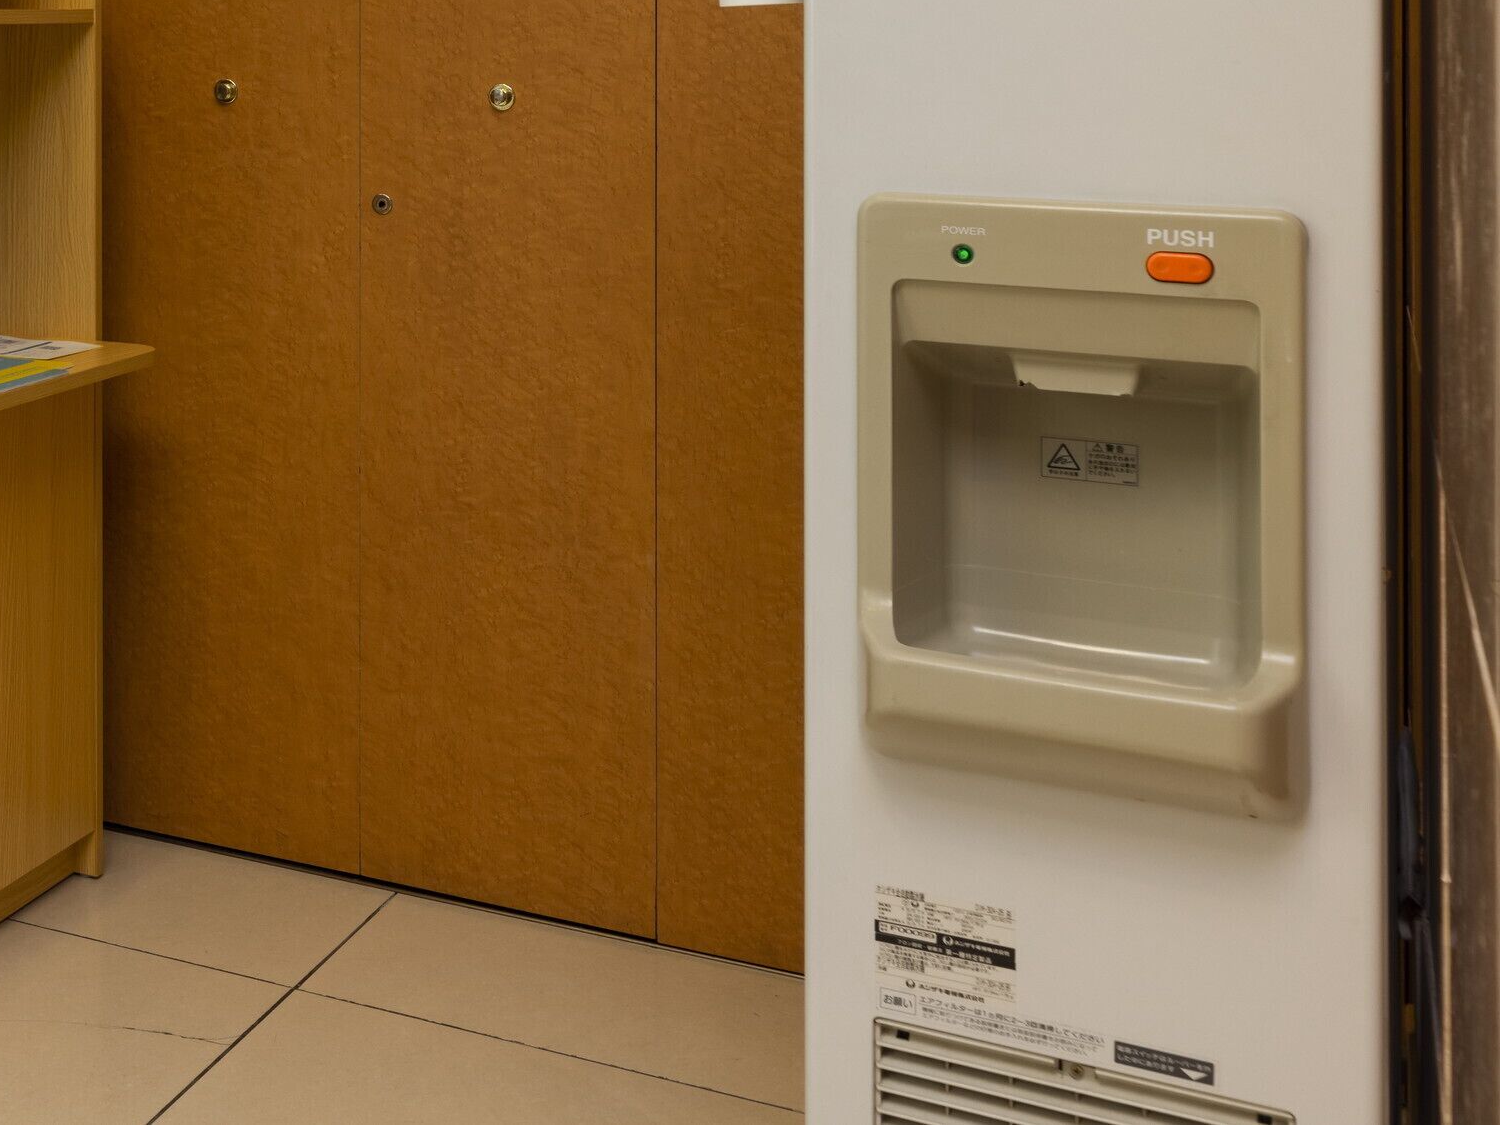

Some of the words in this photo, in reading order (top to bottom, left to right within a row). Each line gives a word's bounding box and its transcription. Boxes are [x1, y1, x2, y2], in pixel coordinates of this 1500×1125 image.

[940, 225, 987, 236] POWER
[1146, 227, 1215, 249] PUSH
[882, 993, 914, 1011] お願い
